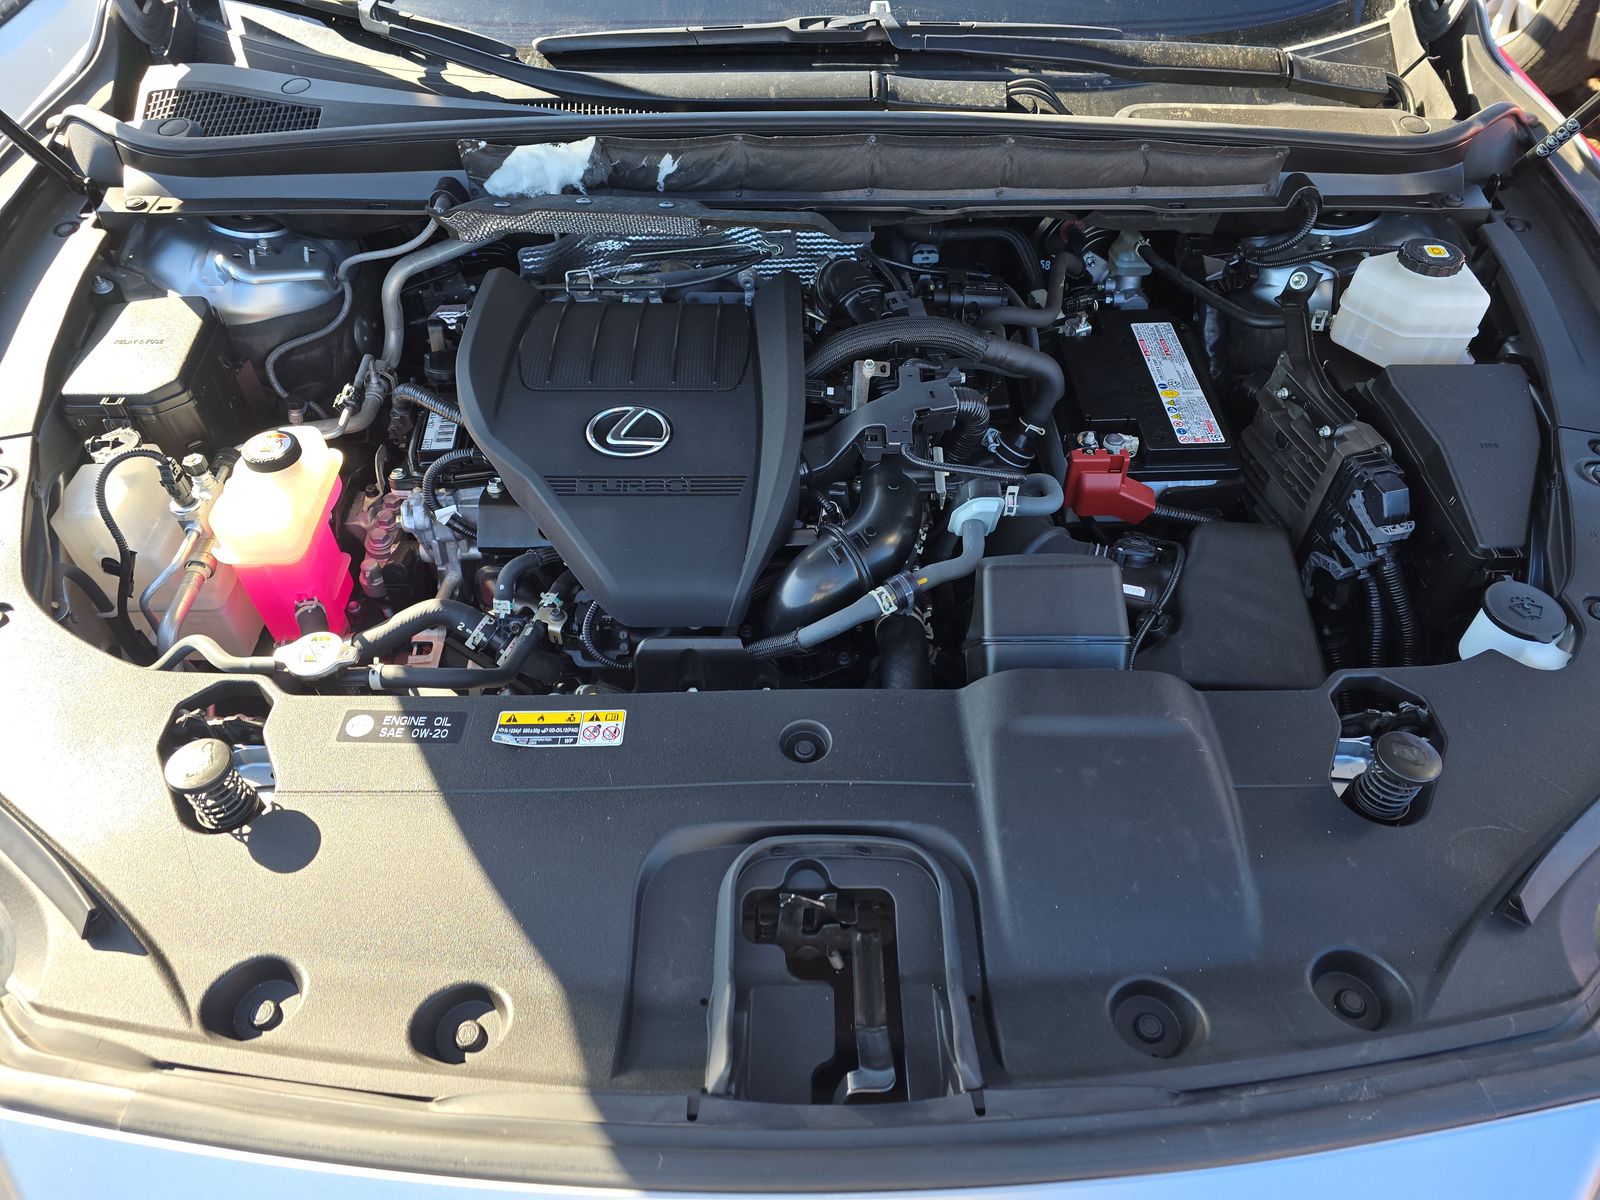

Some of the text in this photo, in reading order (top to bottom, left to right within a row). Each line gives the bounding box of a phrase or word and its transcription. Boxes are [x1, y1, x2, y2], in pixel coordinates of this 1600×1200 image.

[579, 478, 689, 493] TURBO
[382, 715, 452, 727] ENGINE OIL
[378, 727, 449, 739] SAE 0W-20
